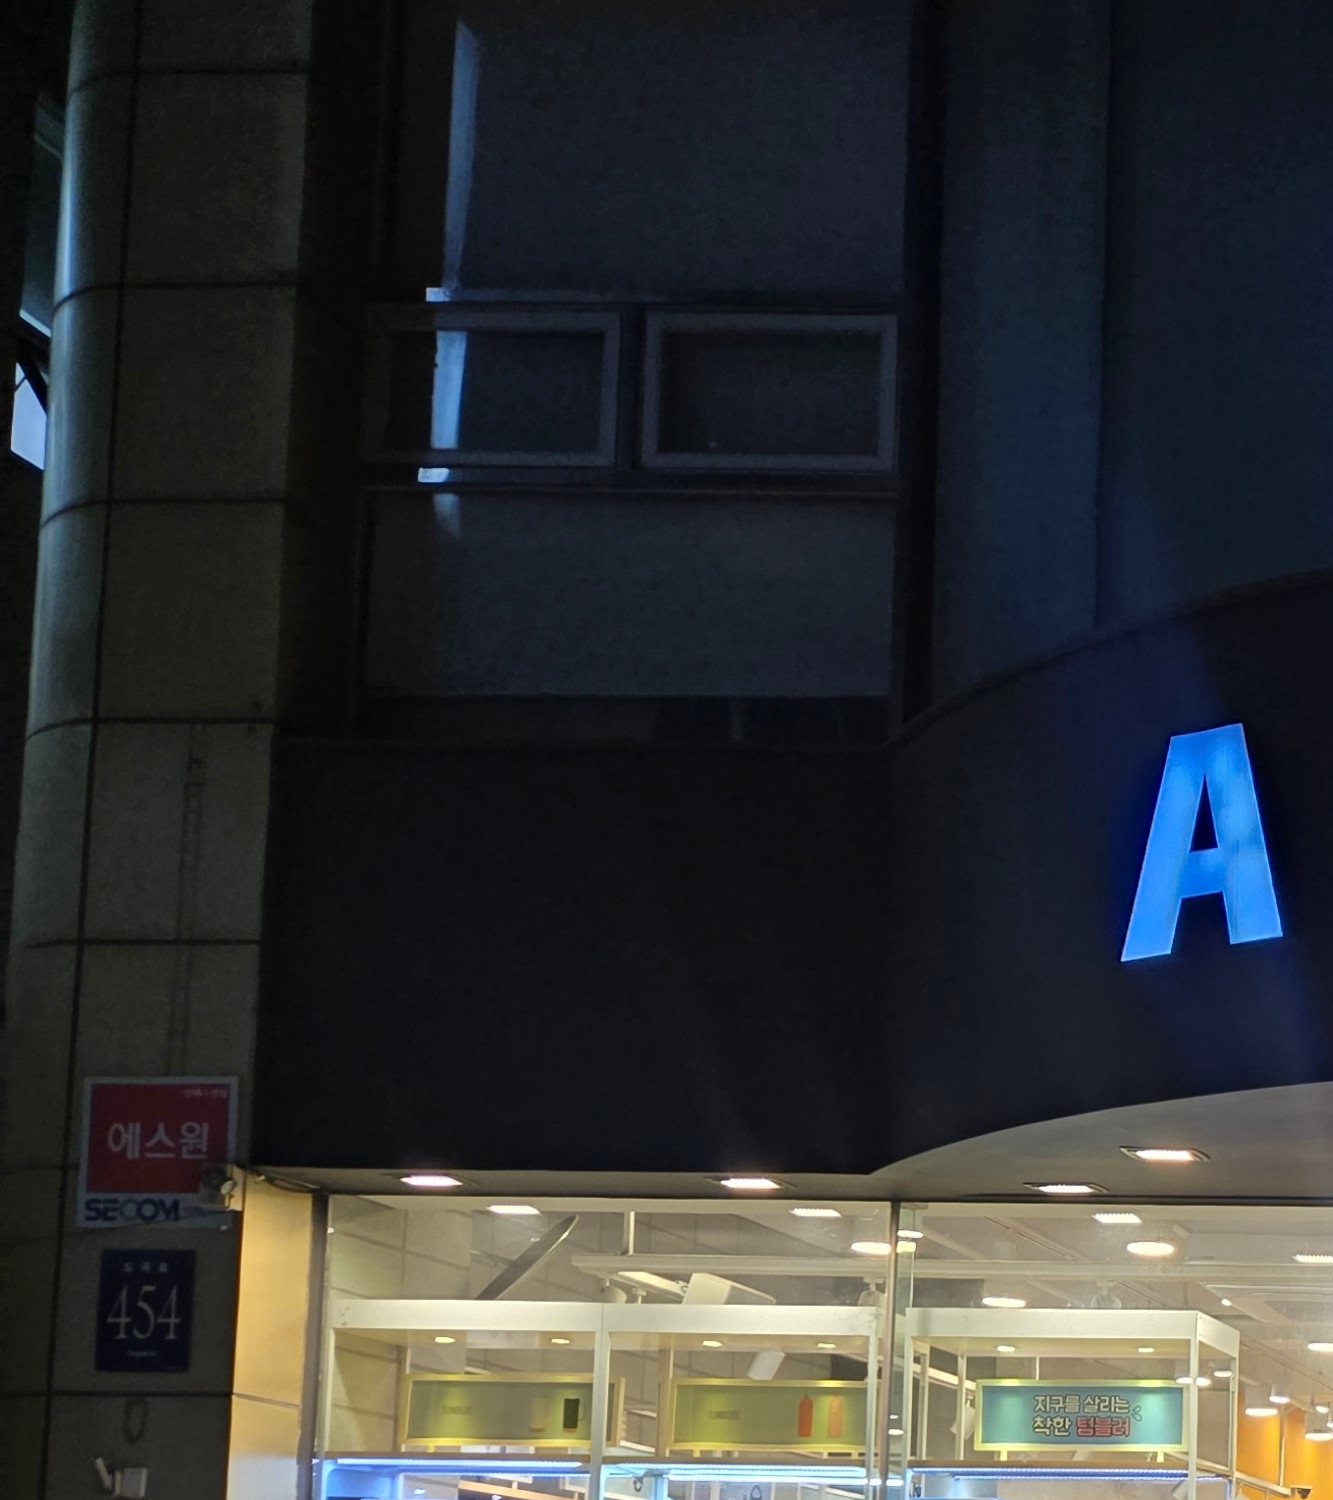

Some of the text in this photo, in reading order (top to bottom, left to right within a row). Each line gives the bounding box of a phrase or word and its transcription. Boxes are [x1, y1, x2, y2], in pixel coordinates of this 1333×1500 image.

[107, 1121, 209, 1160] 에스원
[85, 1198, 180, 1221] SECOM
[107, 1283, 182, 1339] 454
[1034, 1394, 1131, 1414] 지구를 살리는
[1032, 1415, 1132, 1437] 착한 텀블러
